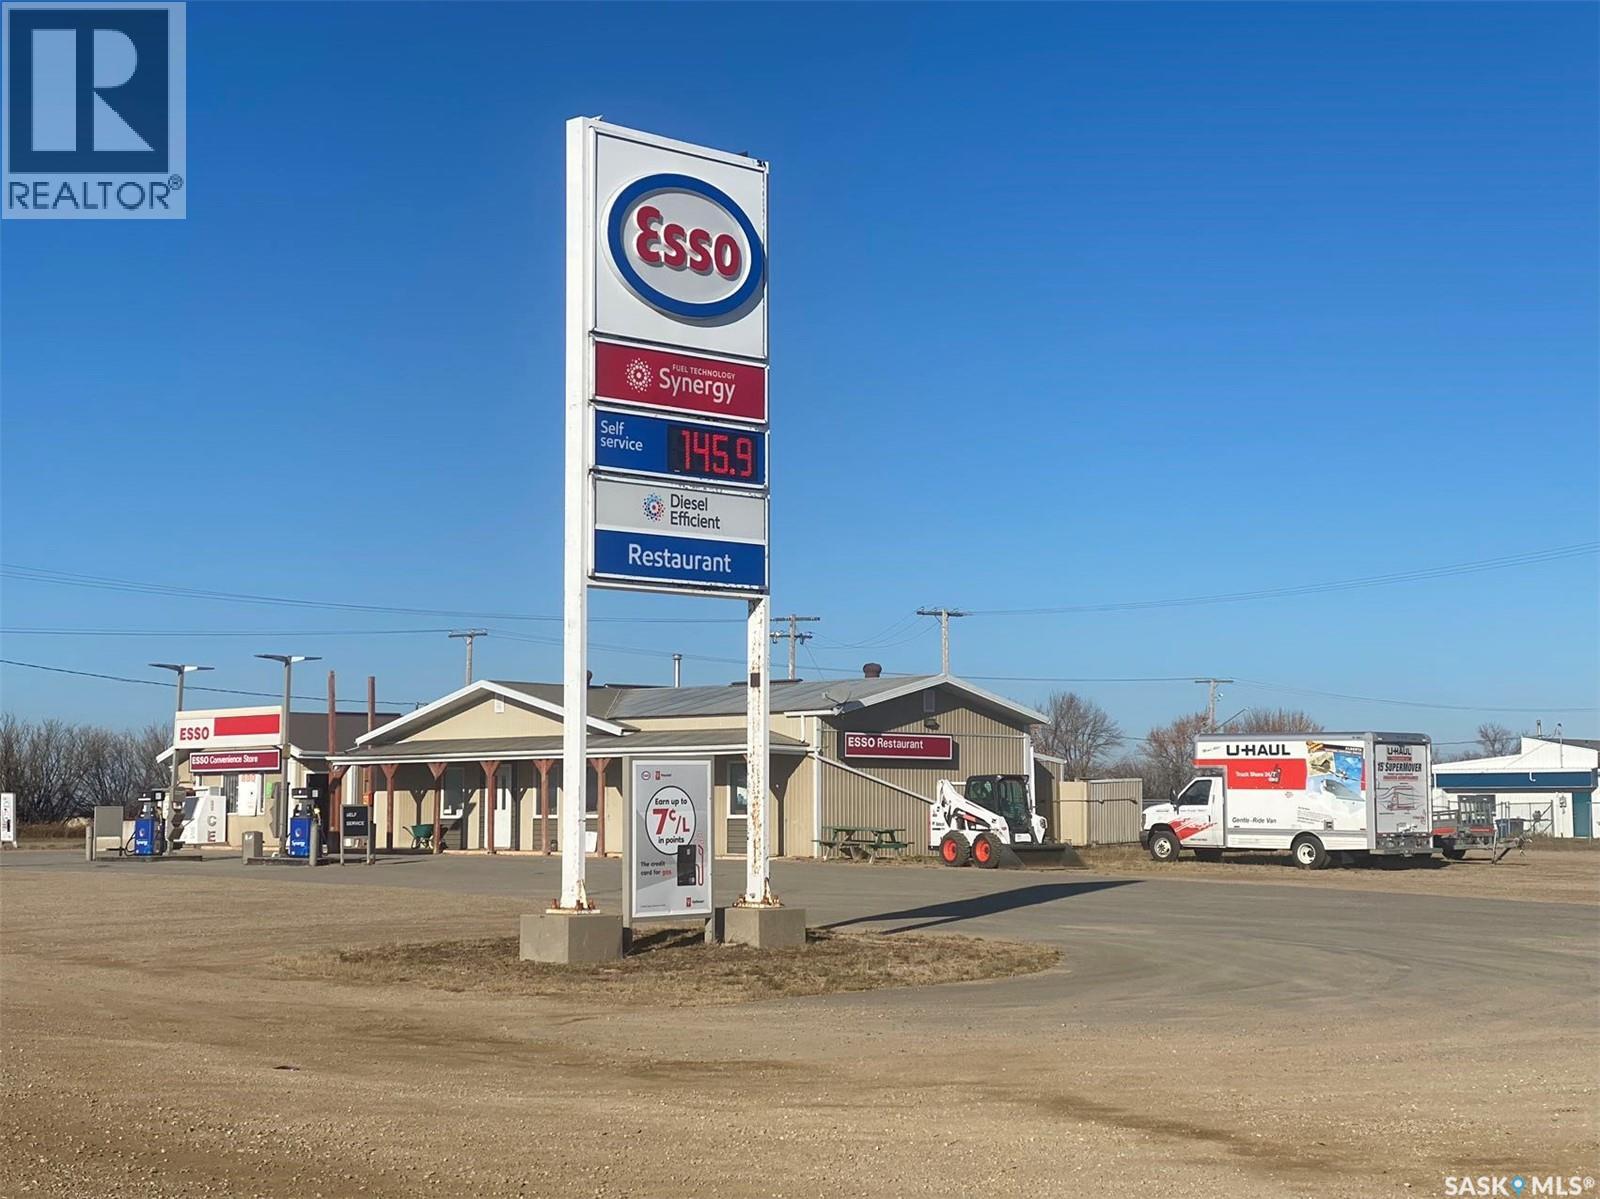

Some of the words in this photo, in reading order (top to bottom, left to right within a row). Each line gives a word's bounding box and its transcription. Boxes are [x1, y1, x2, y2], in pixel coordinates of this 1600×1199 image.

[672, 363, 690, 373] FUEL
[690, 366, 736, 380] TECHNOLOGY
[658, 367, 736, 405] Synergy
[600, 419, 625, 436] Self
[600, 436, 644, 452] service
[680, 429, 754, 478] 145.9
[670, 493, 709, 512] Diesel
[670, 511, 721, 530] Efficient
[628, 543, 732, 573] Restaurant
[179, 726, 210, 741] ESSO
[847, 736, 876, 748] ESSO
[877, 738, 924, 750] Restaurant
[1226, 743, 1291, 757] U-HAUL
[191, 755, 209, 765] ESSO
[210, 755, 243, 765] Convenience
[243, 754, 259, 764] Store
[1385, 762, 1422, 773] SUPERMOVER
[654, 797, 670, 806] Earn
[670, 799, 680, 809] up
[680, 797, 688, 806] to
[1266, 817, 1277, 825] Van
[658, 836, 665, 844] in
[665, 836, 685, 845] points
[640, 869, 653, 877] card
[653, 869, 661, 877] for
[662, 869, 672, 877] gas
